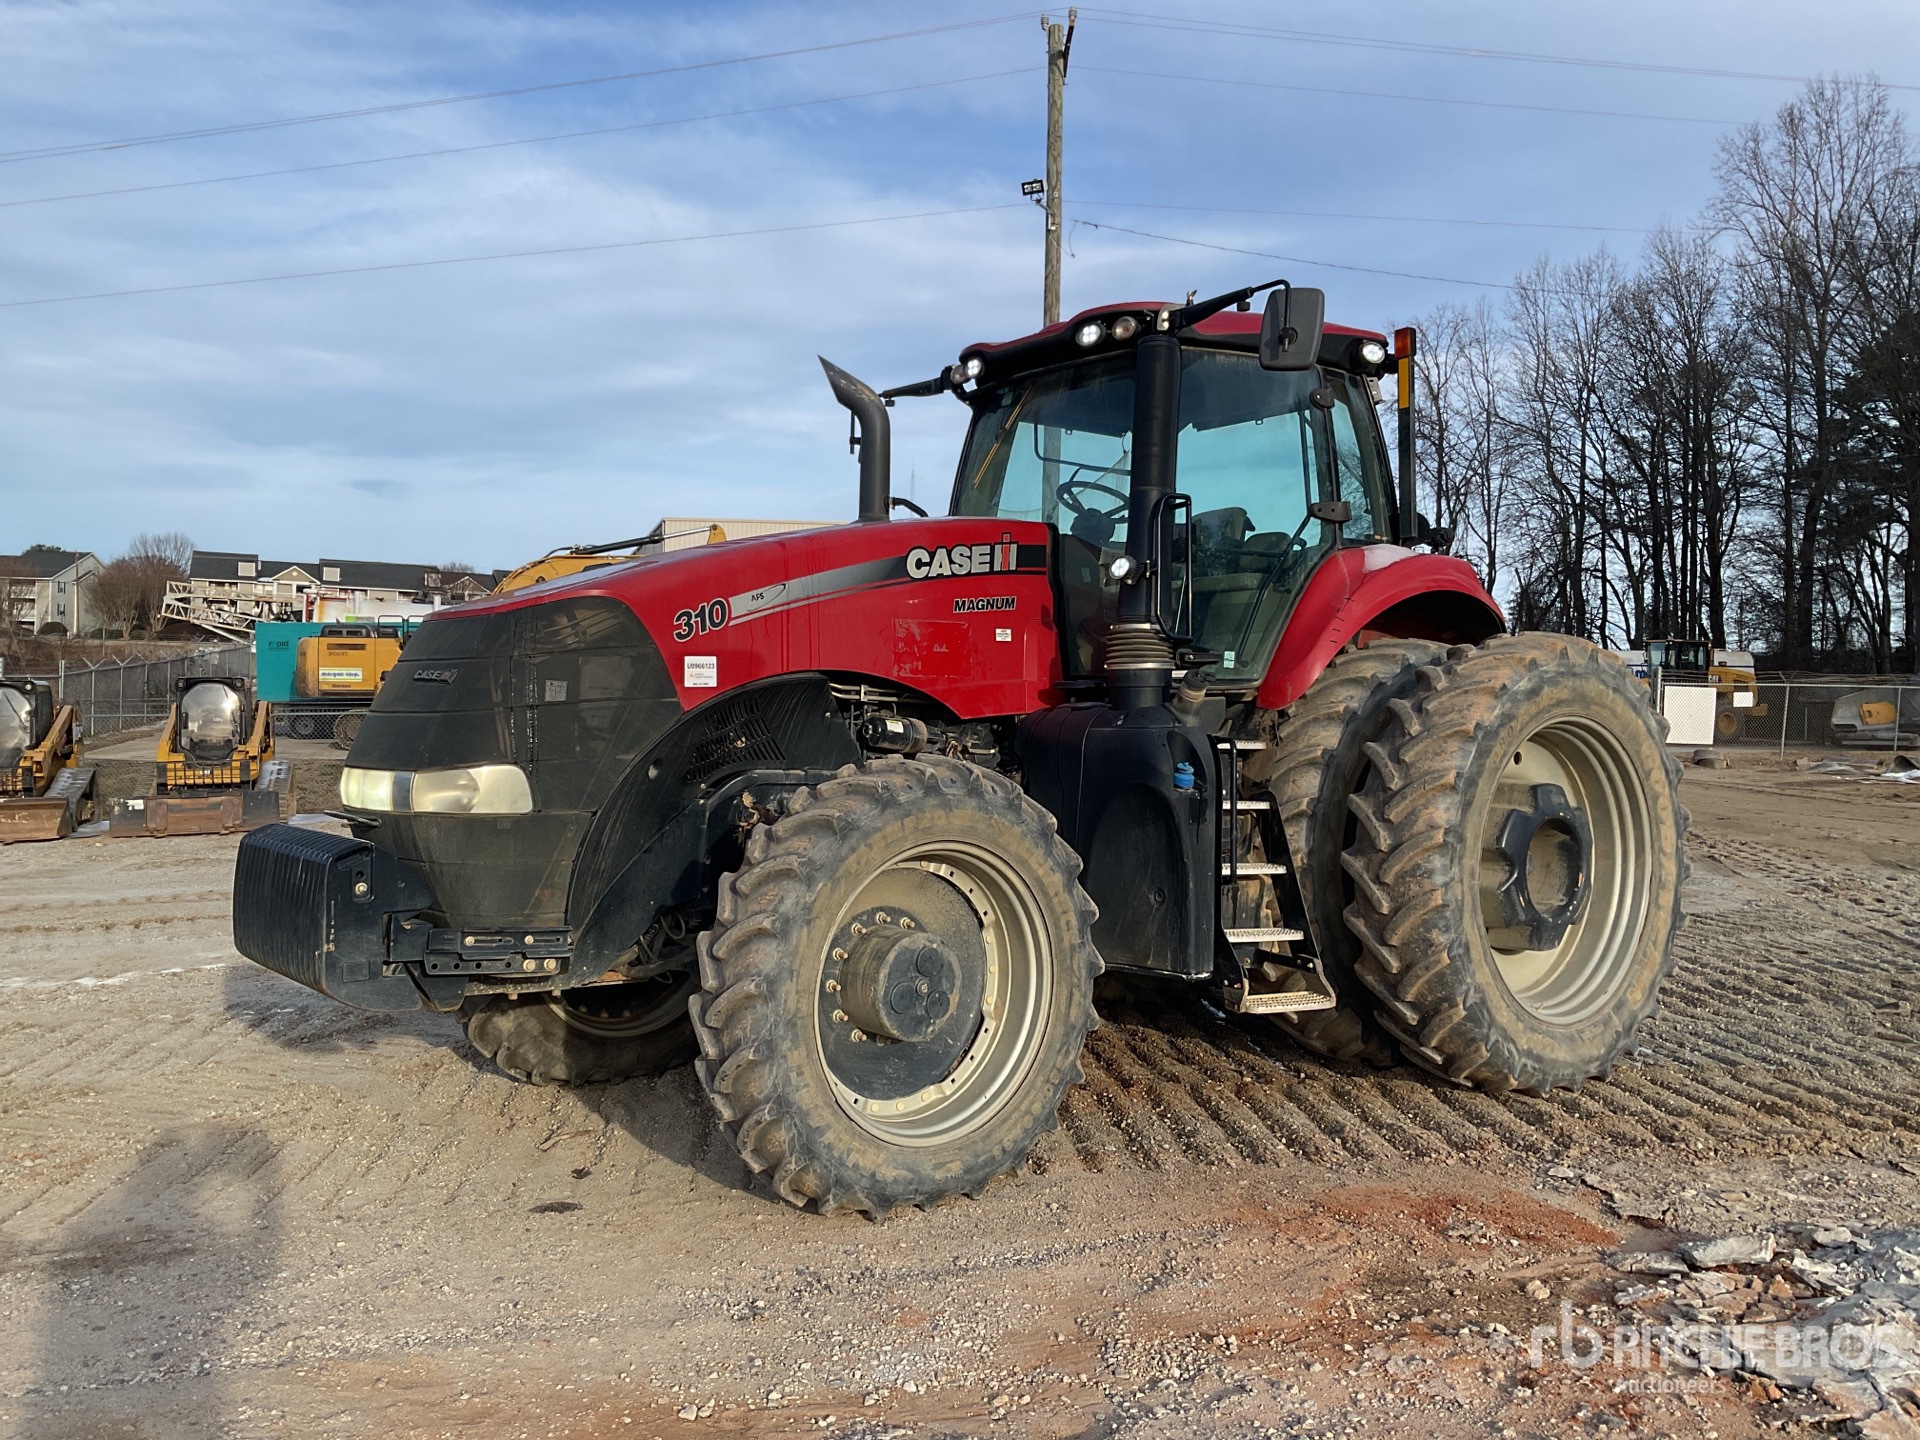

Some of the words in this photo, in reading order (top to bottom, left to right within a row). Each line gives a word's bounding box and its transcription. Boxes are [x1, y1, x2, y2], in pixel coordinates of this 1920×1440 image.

[906, 545, 991, 579] CASE
[751, 592, 765, 602] AFS
[953, 596, 1017, 613] MAGNUM
[673, 597, 728, 642] 310
[413, 669, 442, 679] CASE
